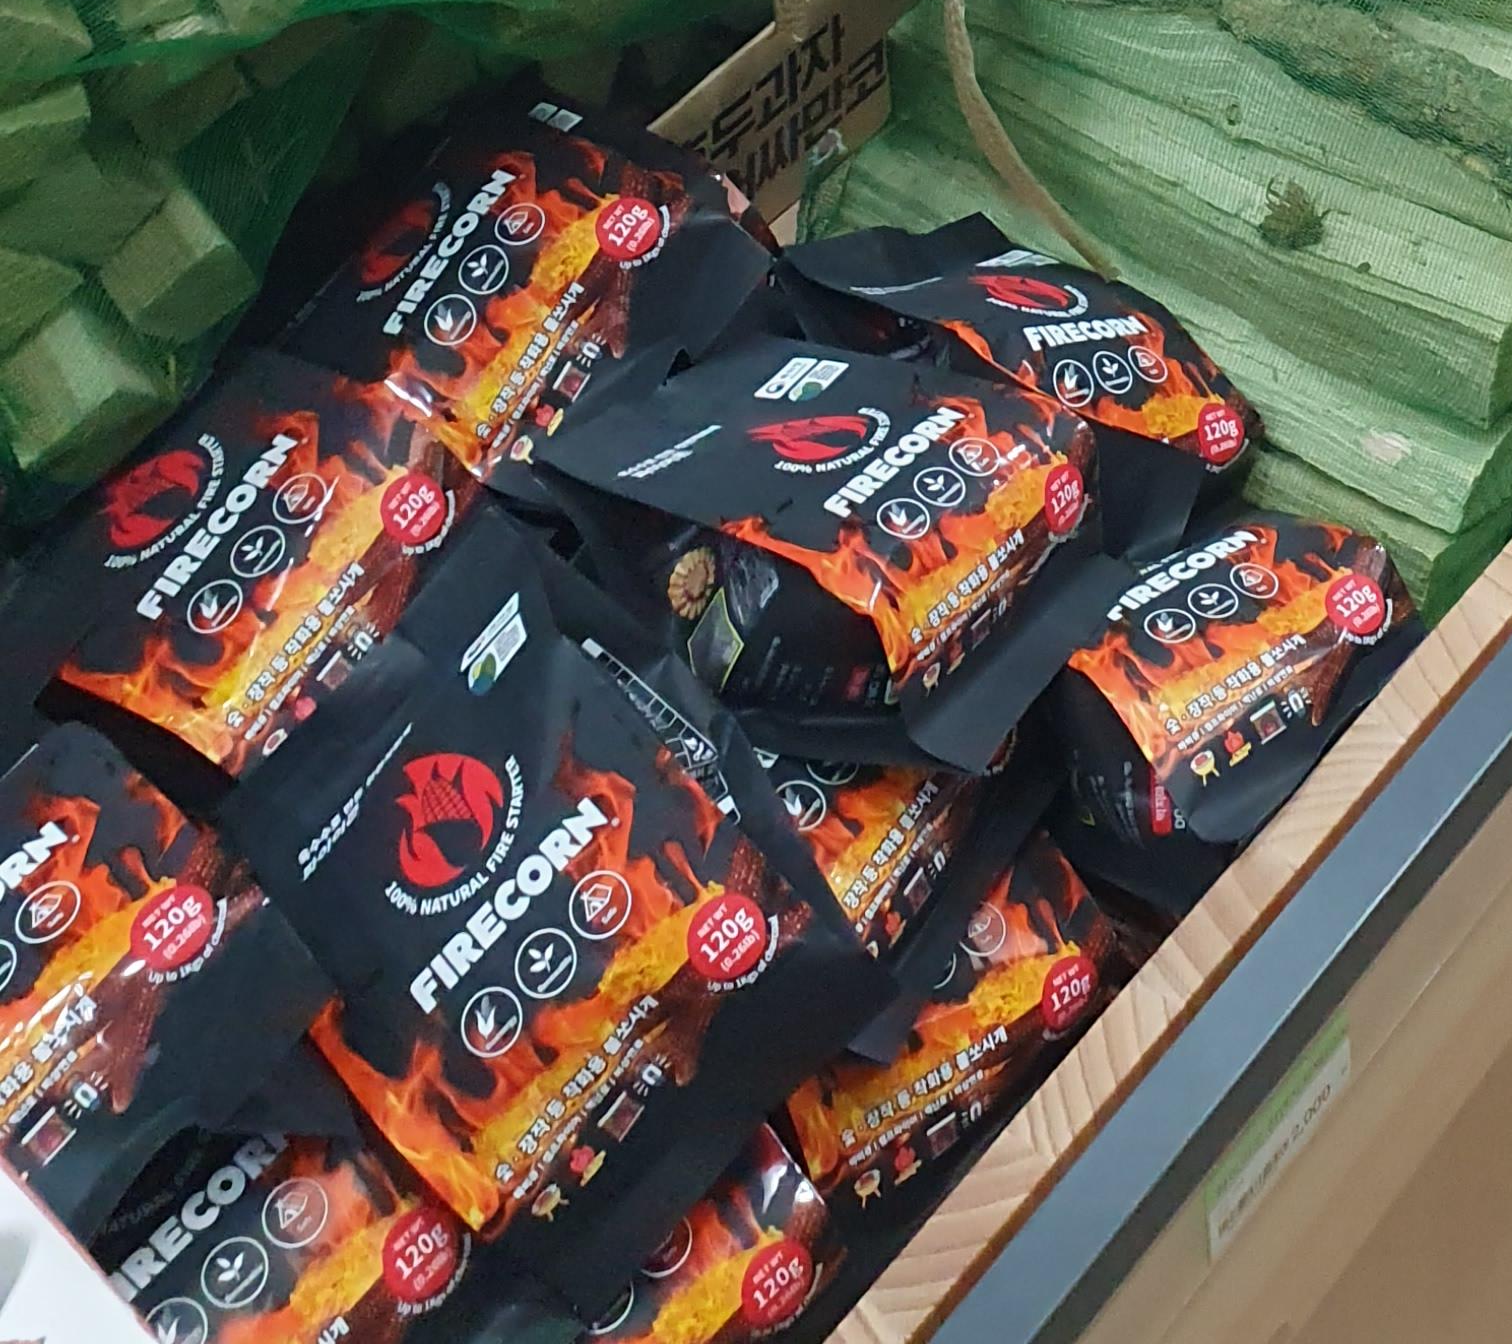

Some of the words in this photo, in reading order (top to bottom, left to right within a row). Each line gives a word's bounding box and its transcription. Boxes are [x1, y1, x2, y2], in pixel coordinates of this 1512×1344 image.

[692, 11, 846, 162] 두과자
[381, 168, 517, 336] FIRECORN
[607, 204, 650, 247] 120g
[491, 384, 514, 415] 장작
[510, 367, 526, 385] 등
[543, 281, 586, 333] 불쏘시개
[1022, 315, 1149, 352] FIRECORN
[773, 459, 813, 476] 100%
[815, 445, 876, 474] NATURAL
[822, 405, 967, 520] FIRECORN
[1203, 416, 1241, 442] 120g
[136, 432, 299, 621] FIRECORN
[139, 512, 201, 562] NATURAL
[197, 478, 222, 510] FIRE
[391, 485, 436, 530] 120g
[1049, 479, 1081, 514] 120g
[926, 600, 952, 626] 장작
[945, 588, 961, 605] 등
[956, 565, 990, 598] 착화용
[984, 527, 1026, 570] 불쏘시개
[1333, 584, 1378, 618] 120g
[246, 671, 275, 703] 장작
[270, 653, 289, 673] 등
[284, 613, 323, 655] 착화용
[315, 561, 366, 617] 불쏘시개
[1165, 717, 1183, 735] 숯
[1185, 696, 1214, 719] 장작
[1212, 682, 1228, 700] 등
[1225, 660, 1264, 691] 착화용
[1257, 633, 1308, 668] 불쏘시개
[385, 878, 419, 915] 100%
[419, 871, 490, 916] NATURAL
[487, 835, 513, 874] FIRE
[504, 754, 527, 837] STARTER
[843, 873, 871, 908] 장작
[861, 858, 880, 879] 등
[873, 825, 906, 868] 착화용
[899, 780, 940, 832] 불쏘시개
[143, 894, 203, 951] 120g
[409, 797, 610, 1014] FIRECORN
[699, 904, 757, 964] 120g
[148, 970, 164, 984] Up
[165, 969, 179, 983] to
[719, 928, 761, 972] (0.26lb)
[1049, 973, 1093, 1012] 120g
[495, 1161, 515, 1183] 숯
[517, 1121, 552, 1155] 장작
[544, 1097, 567, 1121] 등
[560, 1056, 608, 1105] 착화용
[603, 994, 659, 1057] 불쏘시개
[864, 1100, 895, 1129] 장작
[895, 1090, 913, 1109] 등
[912, 1057, 954, 1097] 착화용
[954, 1024, 1010, 1069] 불쏘시개
[108, 1132, 289, 1302] IRECOR
[396, 1224, 450, 1280] 120g
[751, 1255, 806, 1313] 120g
